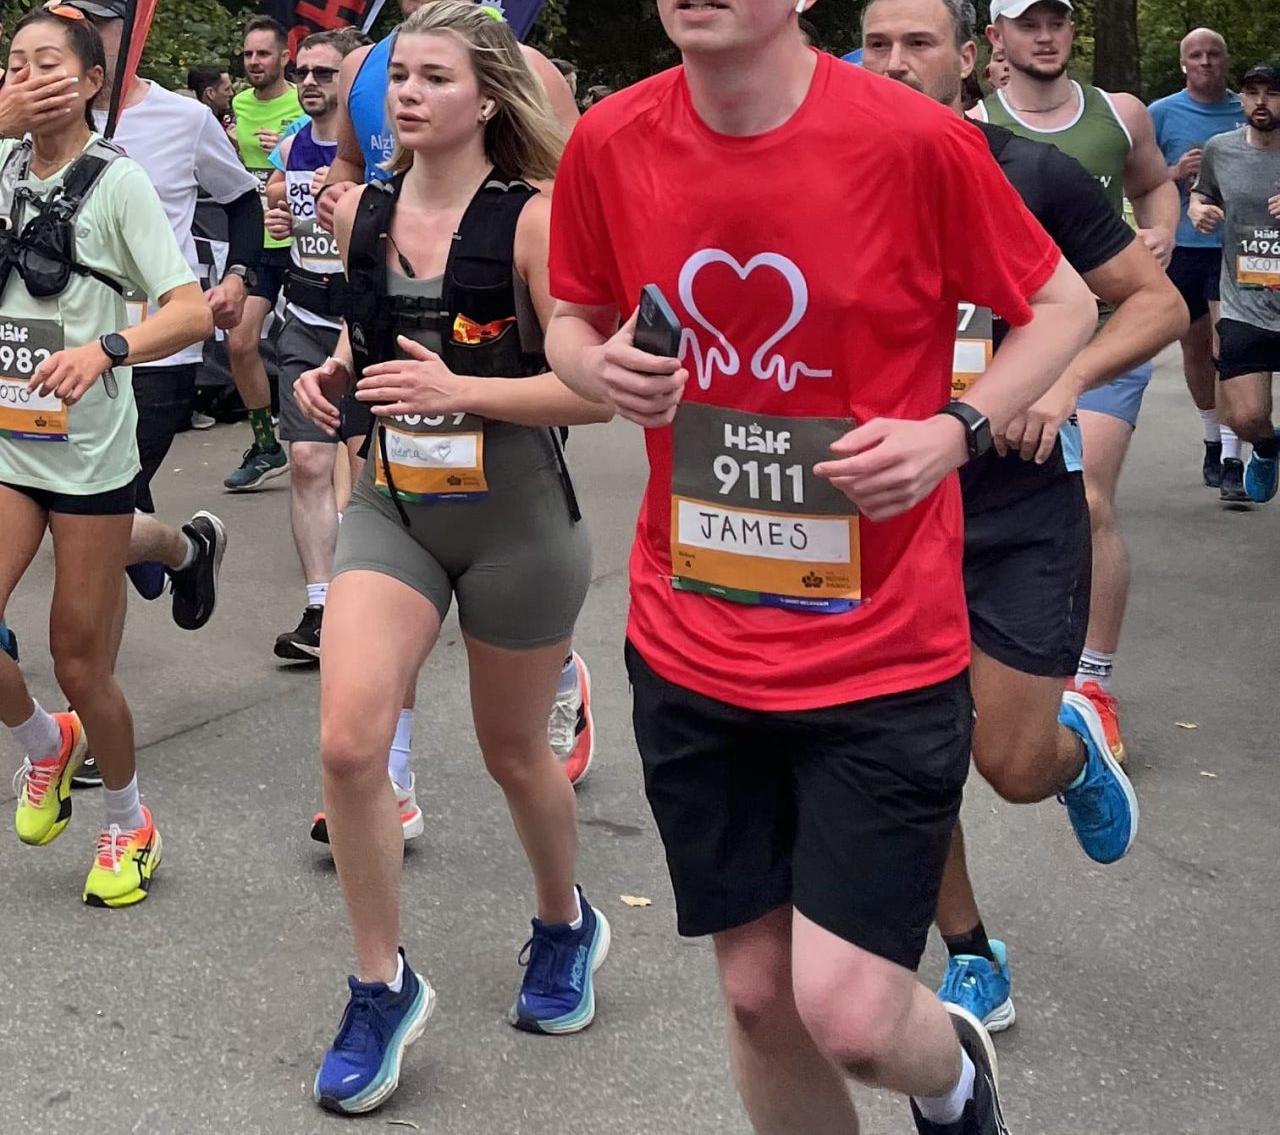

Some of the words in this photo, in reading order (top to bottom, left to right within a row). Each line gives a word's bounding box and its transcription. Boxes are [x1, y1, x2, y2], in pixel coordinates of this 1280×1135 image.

[724, 422, 791, 455] Half
[713, 455, 804, 504] 9111
[699, 512, 808, 550] JAMES
